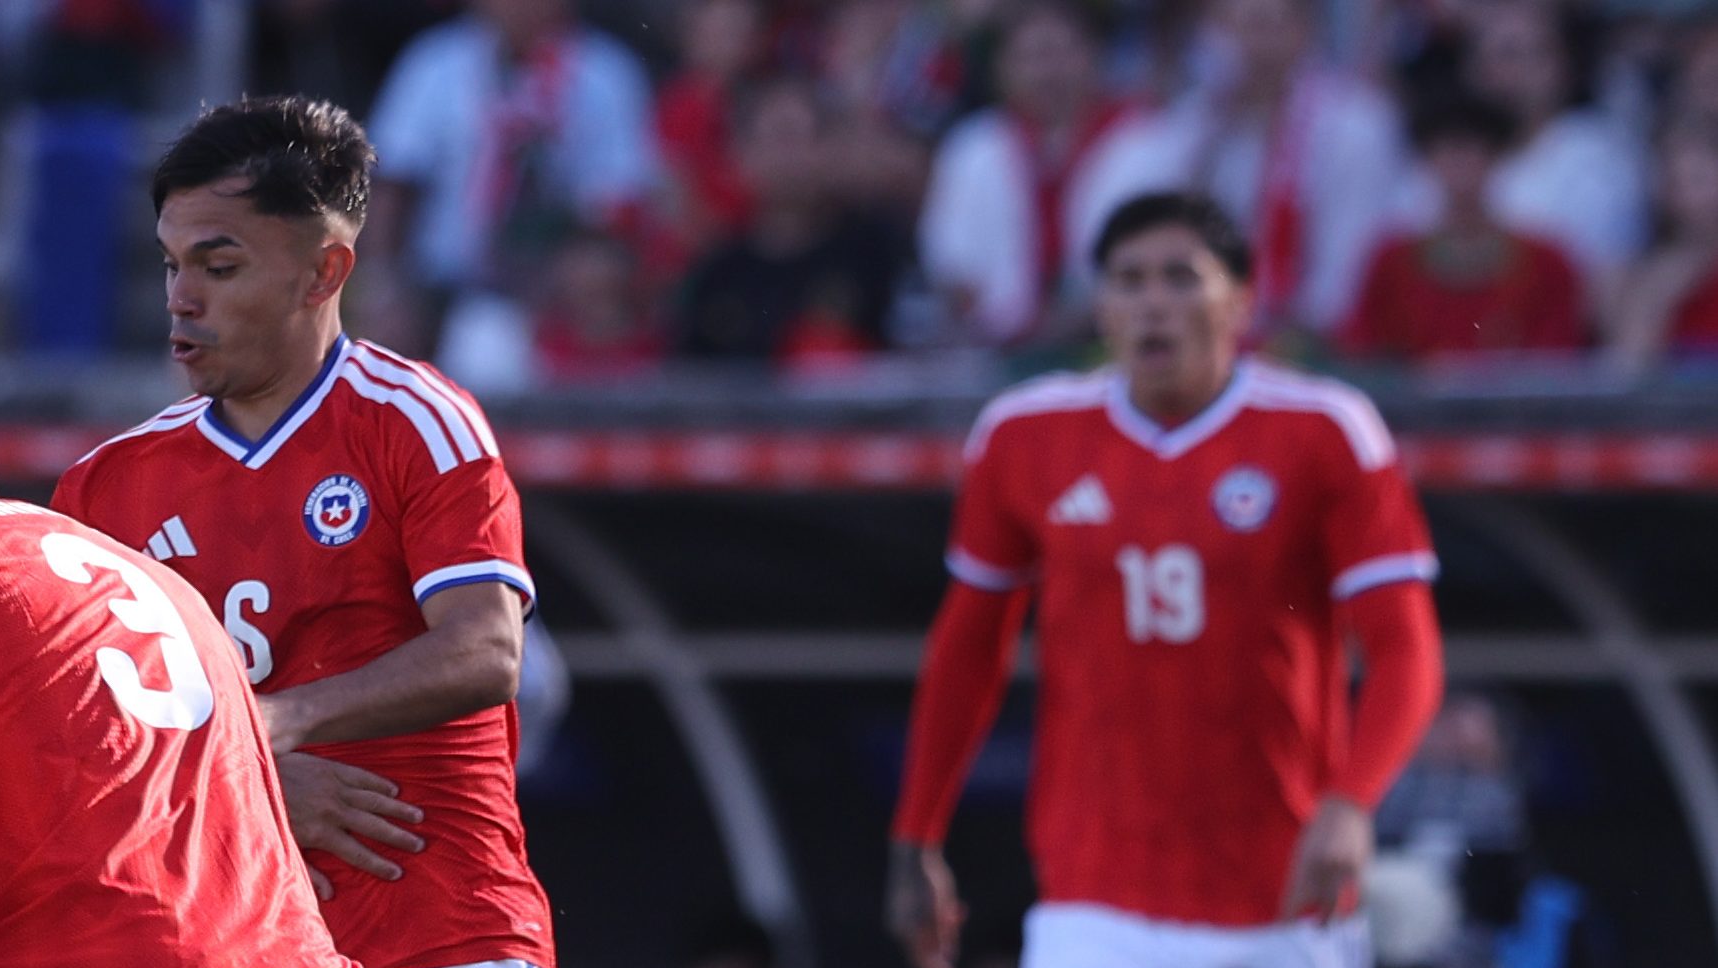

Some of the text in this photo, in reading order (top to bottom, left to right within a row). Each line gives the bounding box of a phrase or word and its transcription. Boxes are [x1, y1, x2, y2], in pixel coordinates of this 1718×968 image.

[41, 532, 214, 731] 3
[224, 579, 273, 685] 6
[1116, 543, 1205, 644] 19
